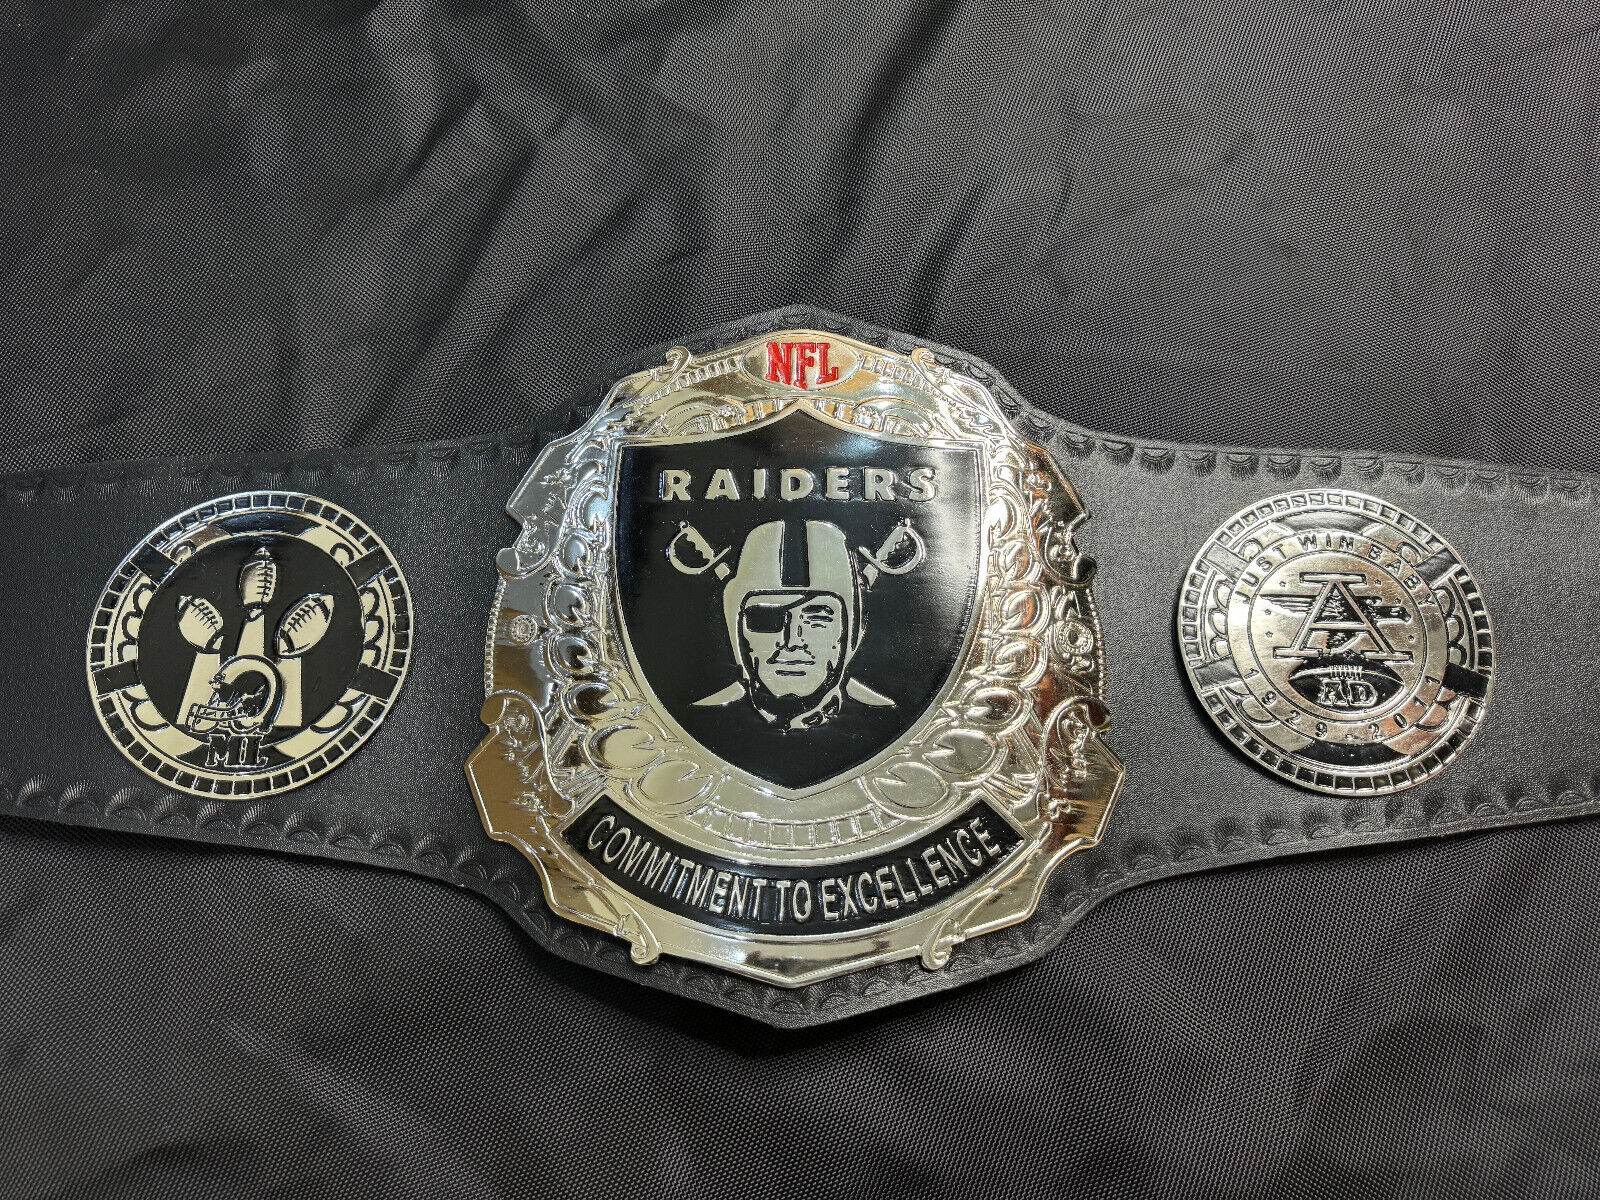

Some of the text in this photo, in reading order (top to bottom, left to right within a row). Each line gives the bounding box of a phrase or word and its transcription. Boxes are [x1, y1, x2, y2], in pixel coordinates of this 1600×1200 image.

[764, 341, 839, 390] NFL
[659, 467, 937, 501] RAIDERS
[1233, 532, 1439, 606] JUST WIN BABY
[1317, 680, 1379, 707] AD
[586, 814, 1001, 922] COMMITMENT TO EXCELLENCE
